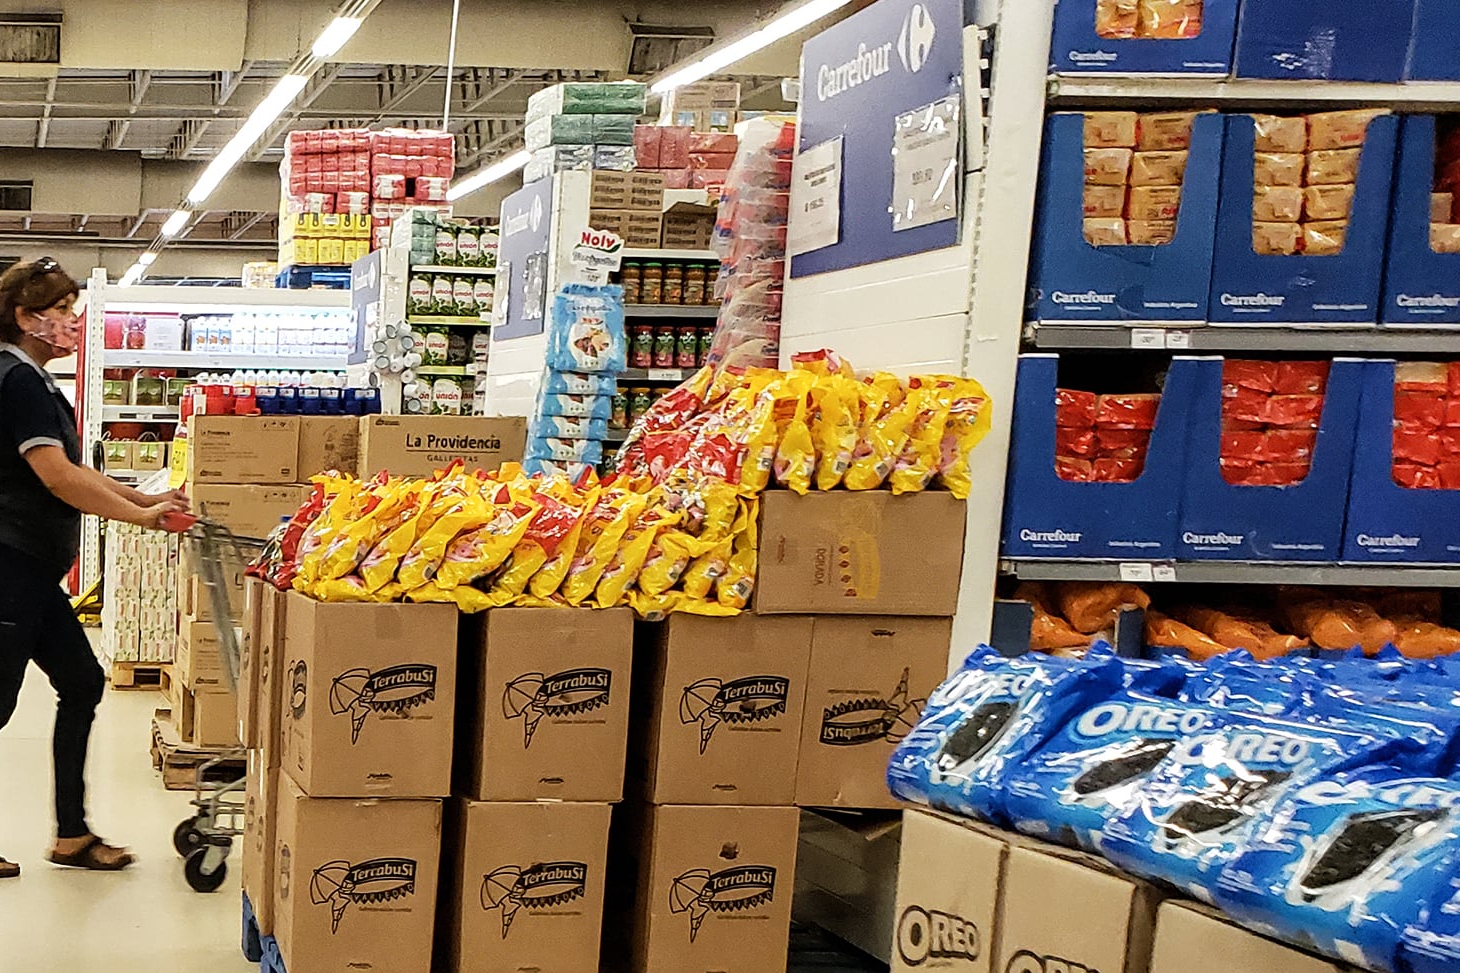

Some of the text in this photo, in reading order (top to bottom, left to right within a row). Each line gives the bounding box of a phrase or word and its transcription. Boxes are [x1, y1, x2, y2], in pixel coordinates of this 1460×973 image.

[817, 41, 893, 102] Carrefour
[1051, 290, 1116, 304] Carrefour
[1220, 293, 1285, 307] Carrefour
[405, 433, 501, 449] La Providencia
[1020, 529, 1082, 542] Carrefour
[1182, 531, 1244, 545] Carrefour
[1357, 532, 1421, 547] Carrefour
[372, 668, 434, 690] TerrabuSi
[545, 672, 608, 695] TerrabuSi
[723, 681, 786, 701] TerrabuSi
[1077, 702, 1207, 737] OREO
[1174, 733, 1309, 765] OREO
[351, 862, 413, 883] TerrabuSi
[522, 867, 584, 888] TerrabuSi
[712, 871, 773, 890] TerrabuSi
[897, 905, 981, 967] OREO
